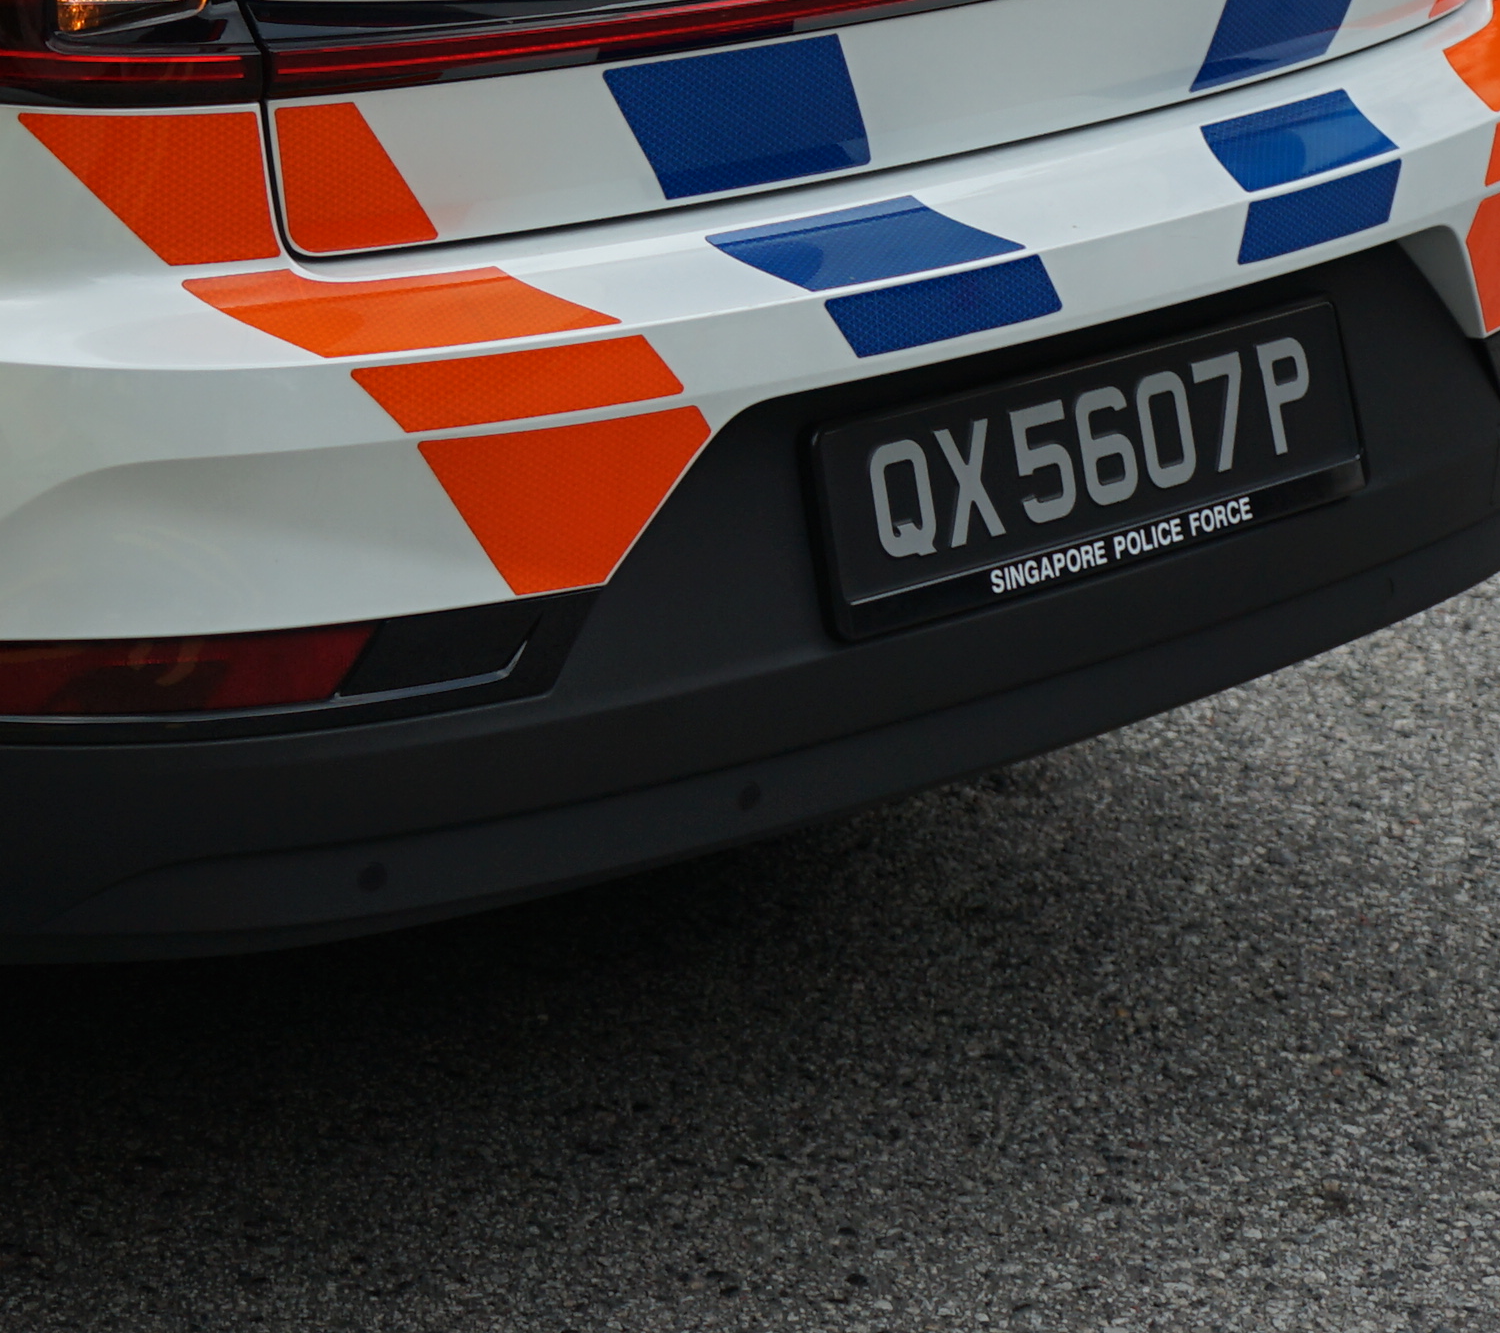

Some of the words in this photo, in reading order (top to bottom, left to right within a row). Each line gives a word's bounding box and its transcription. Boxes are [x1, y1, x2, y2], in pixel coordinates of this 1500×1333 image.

[869, 336, 1310, 558] QX5607P
[989, 543, 1107, 594] SINGAPORE
[1113, 519, 1184, 560] POLICE
[1190, 497, 1254, 537] FORCE
